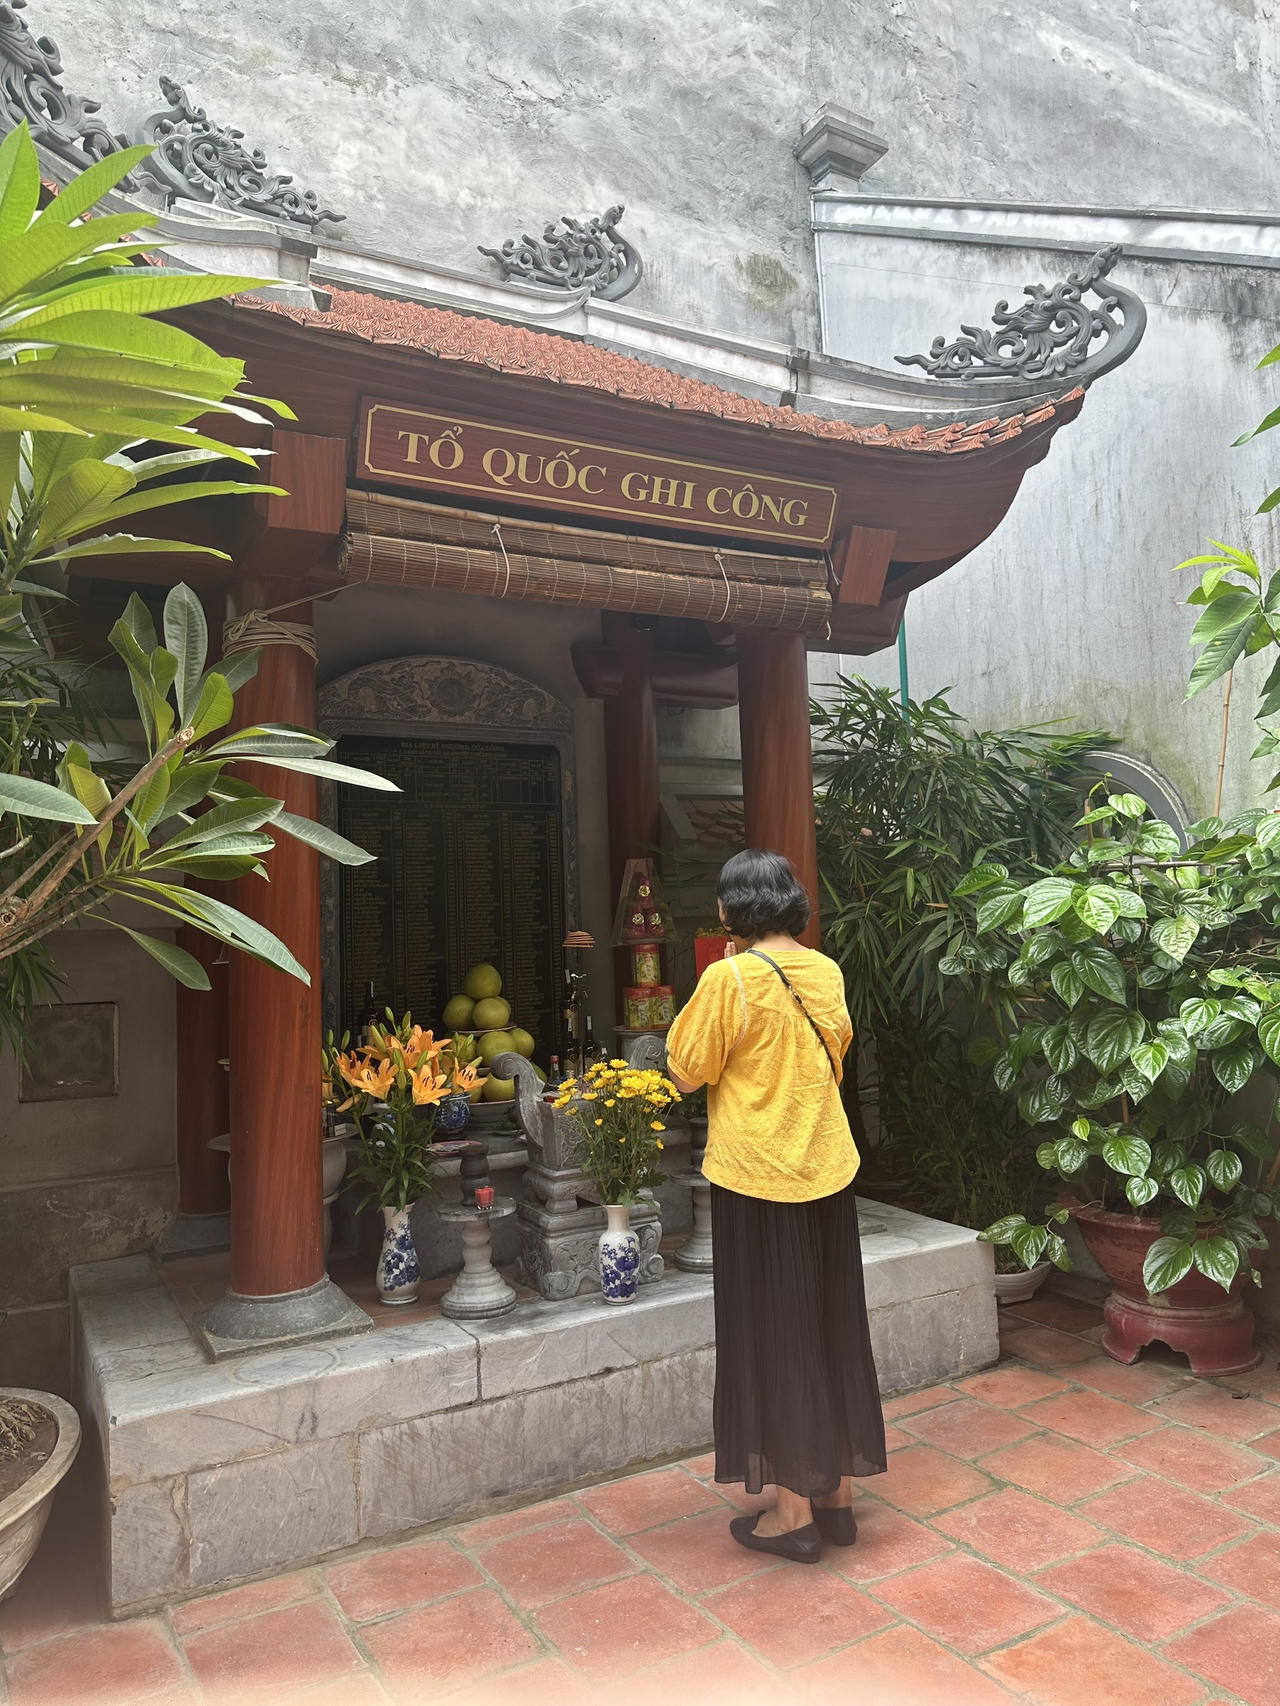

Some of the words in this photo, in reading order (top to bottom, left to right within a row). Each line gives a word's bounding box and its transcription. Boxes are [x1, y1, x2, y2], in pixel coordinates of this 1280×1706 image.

[398, 426, 464, 470] TỔ
[482, 448, 607, 494] QUỐC
[621, 472, 697, 509] GHI
[706, 484, 809, 526] CÔNG
